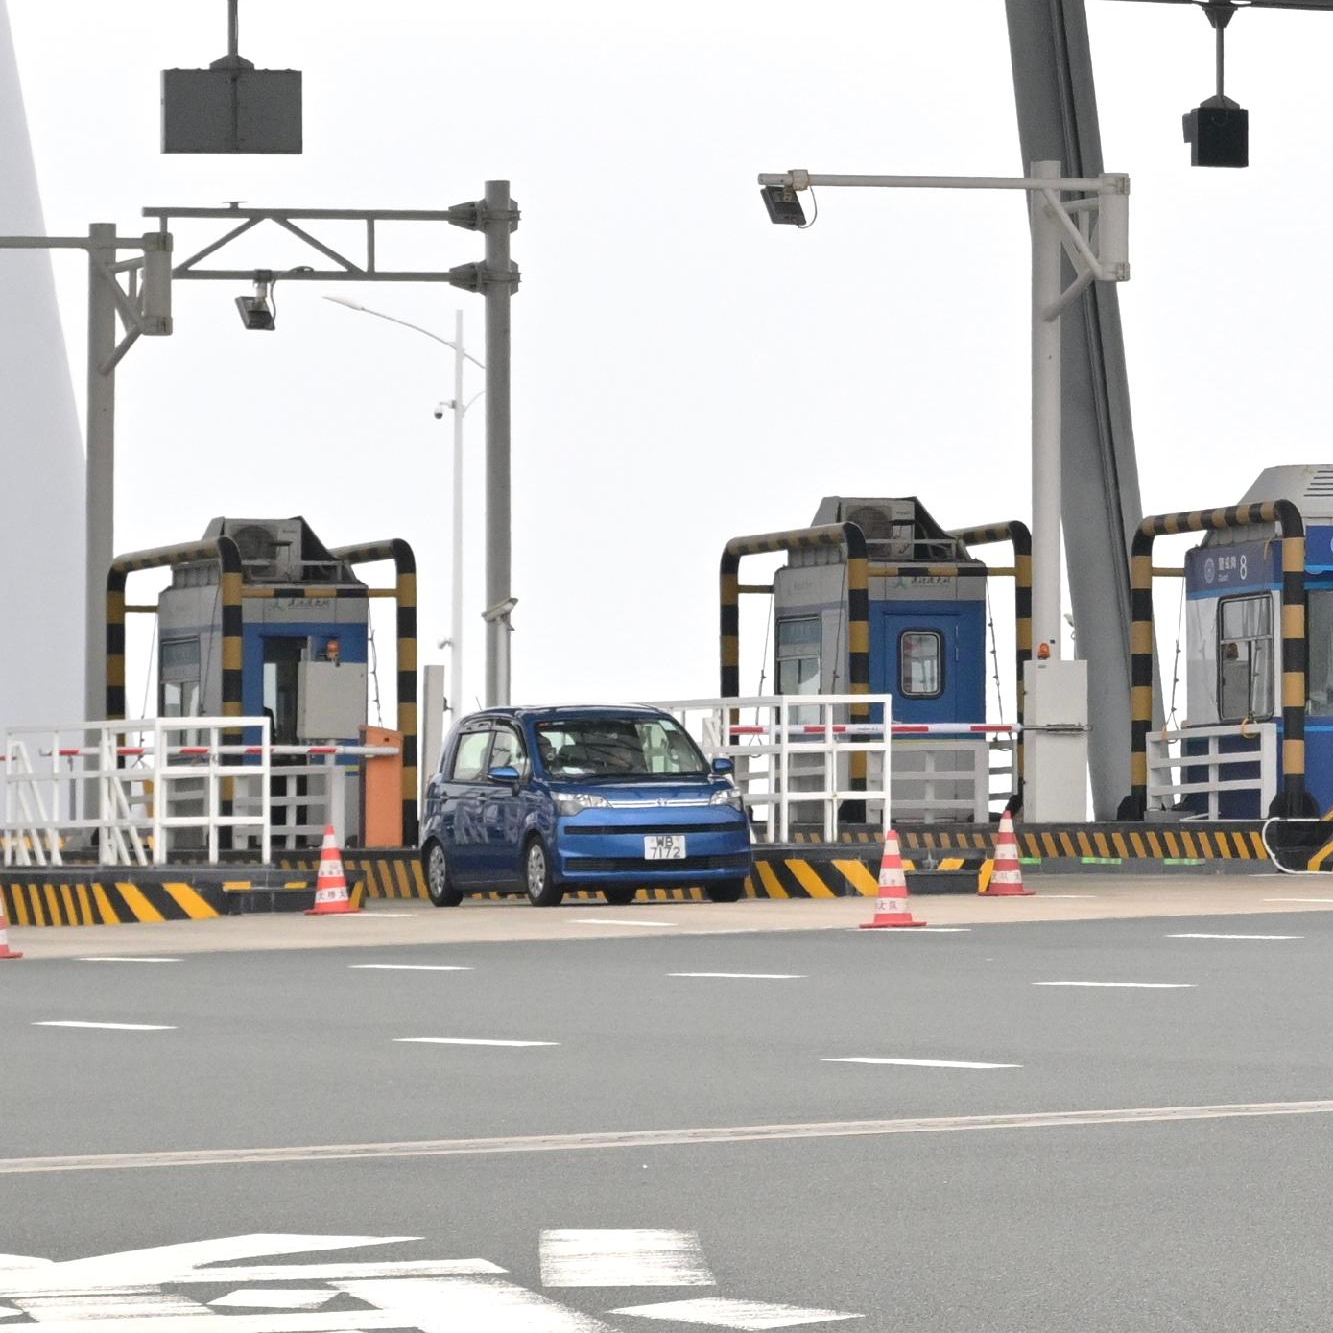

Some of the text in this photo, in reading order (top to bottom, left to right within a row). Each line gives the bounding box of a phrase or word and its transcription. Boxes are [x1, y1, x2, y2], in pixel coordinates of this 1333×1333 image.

[1240, 554, 1248, 580] 8
[656, 836, 674, 847] WB
[650, 847, 681, 859] 7172
